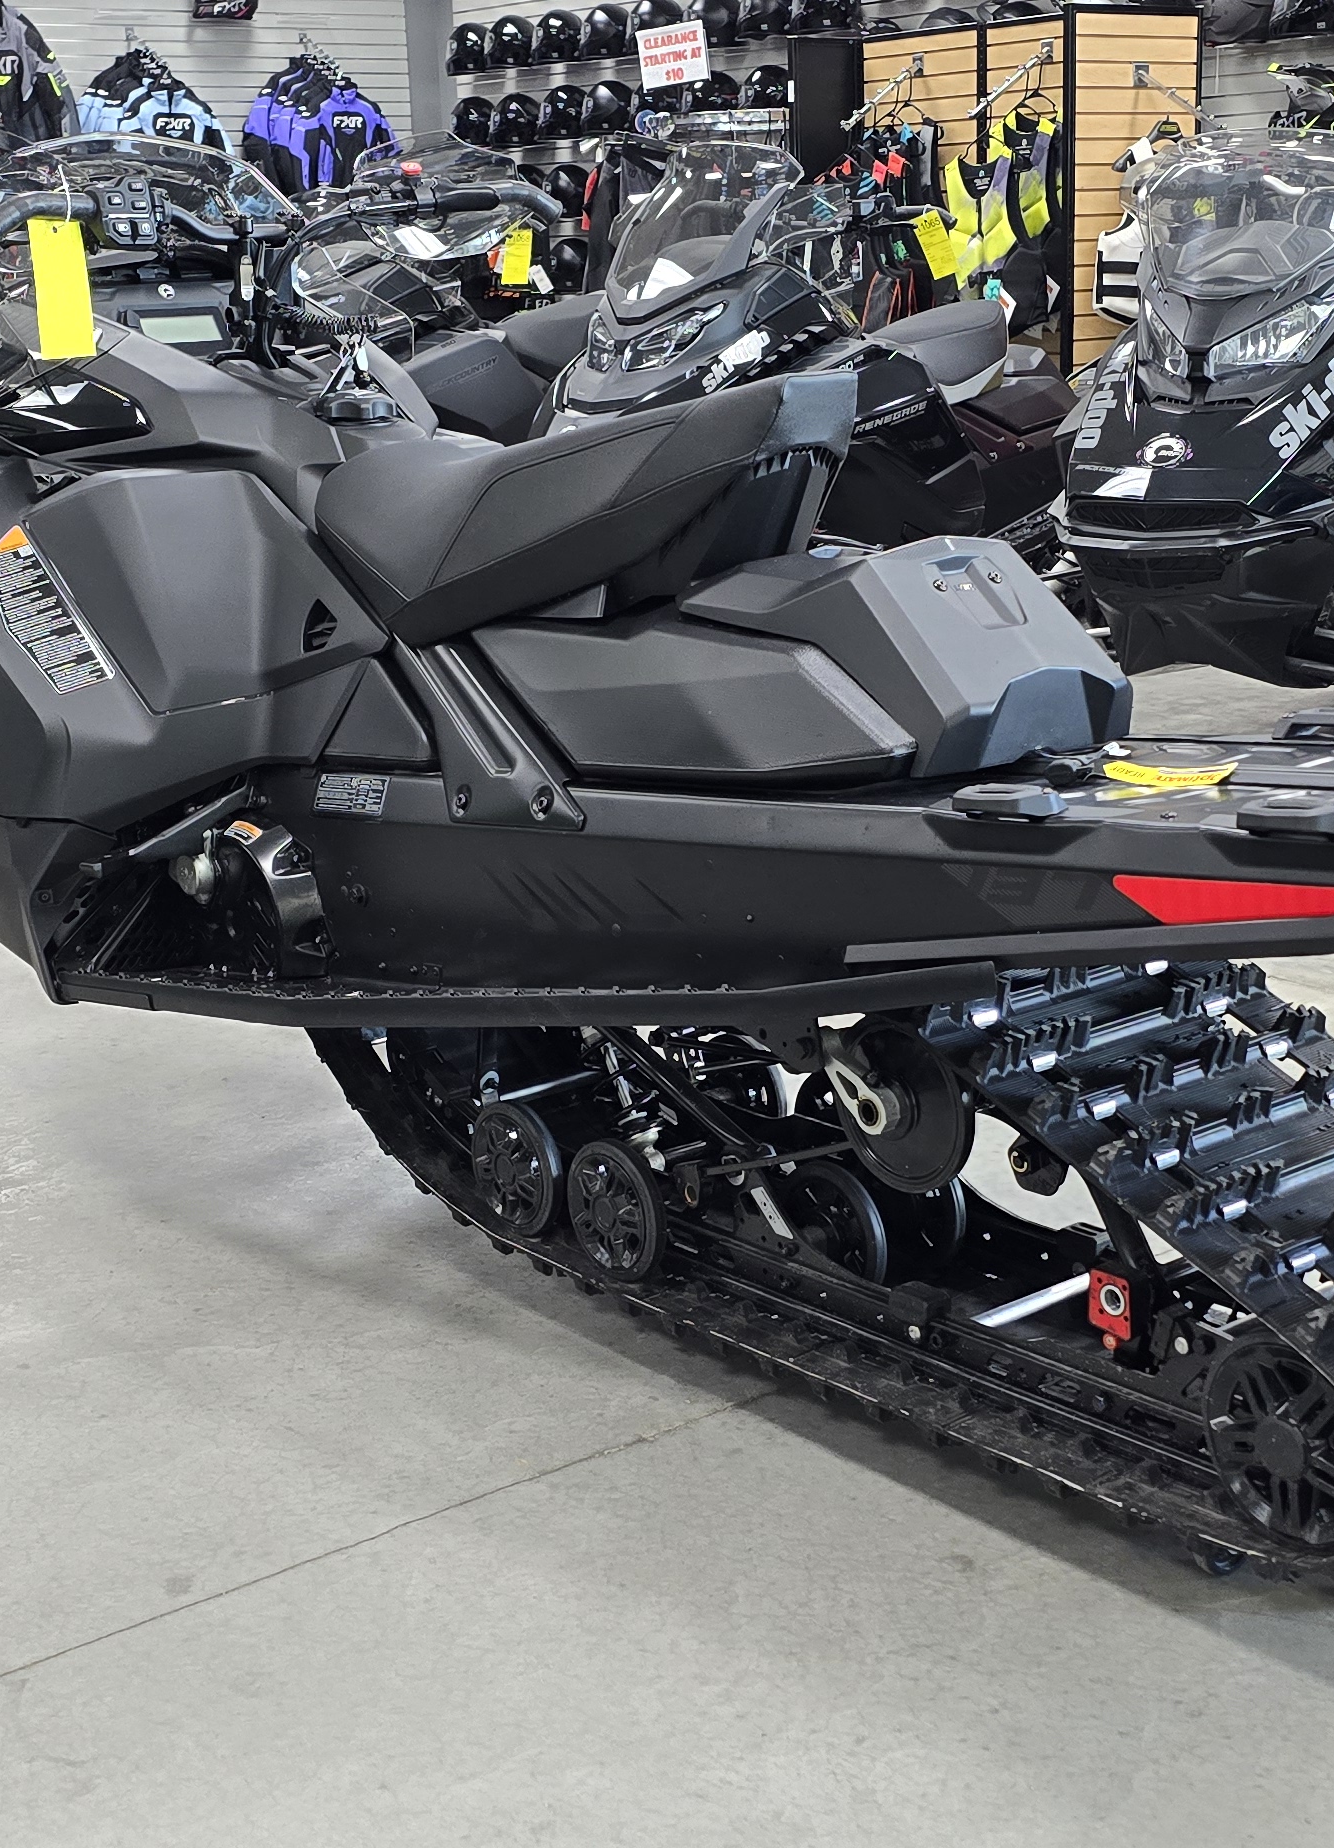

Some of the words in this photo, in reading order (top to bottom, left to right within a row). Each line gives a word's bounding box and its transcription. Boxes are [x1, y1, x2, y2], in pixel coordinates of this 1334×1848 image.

[643, 30, 698, 50] CLEARANCE
[643, 50, 687, 67] STARTING
[690, 46, 702, 60] AT
[665, 67, 684, 81] $10
[155, 116, 191, 131] FXR
[332, 115, 364, 129] FXR
[853, 400, 928, 434] RENEGADE
